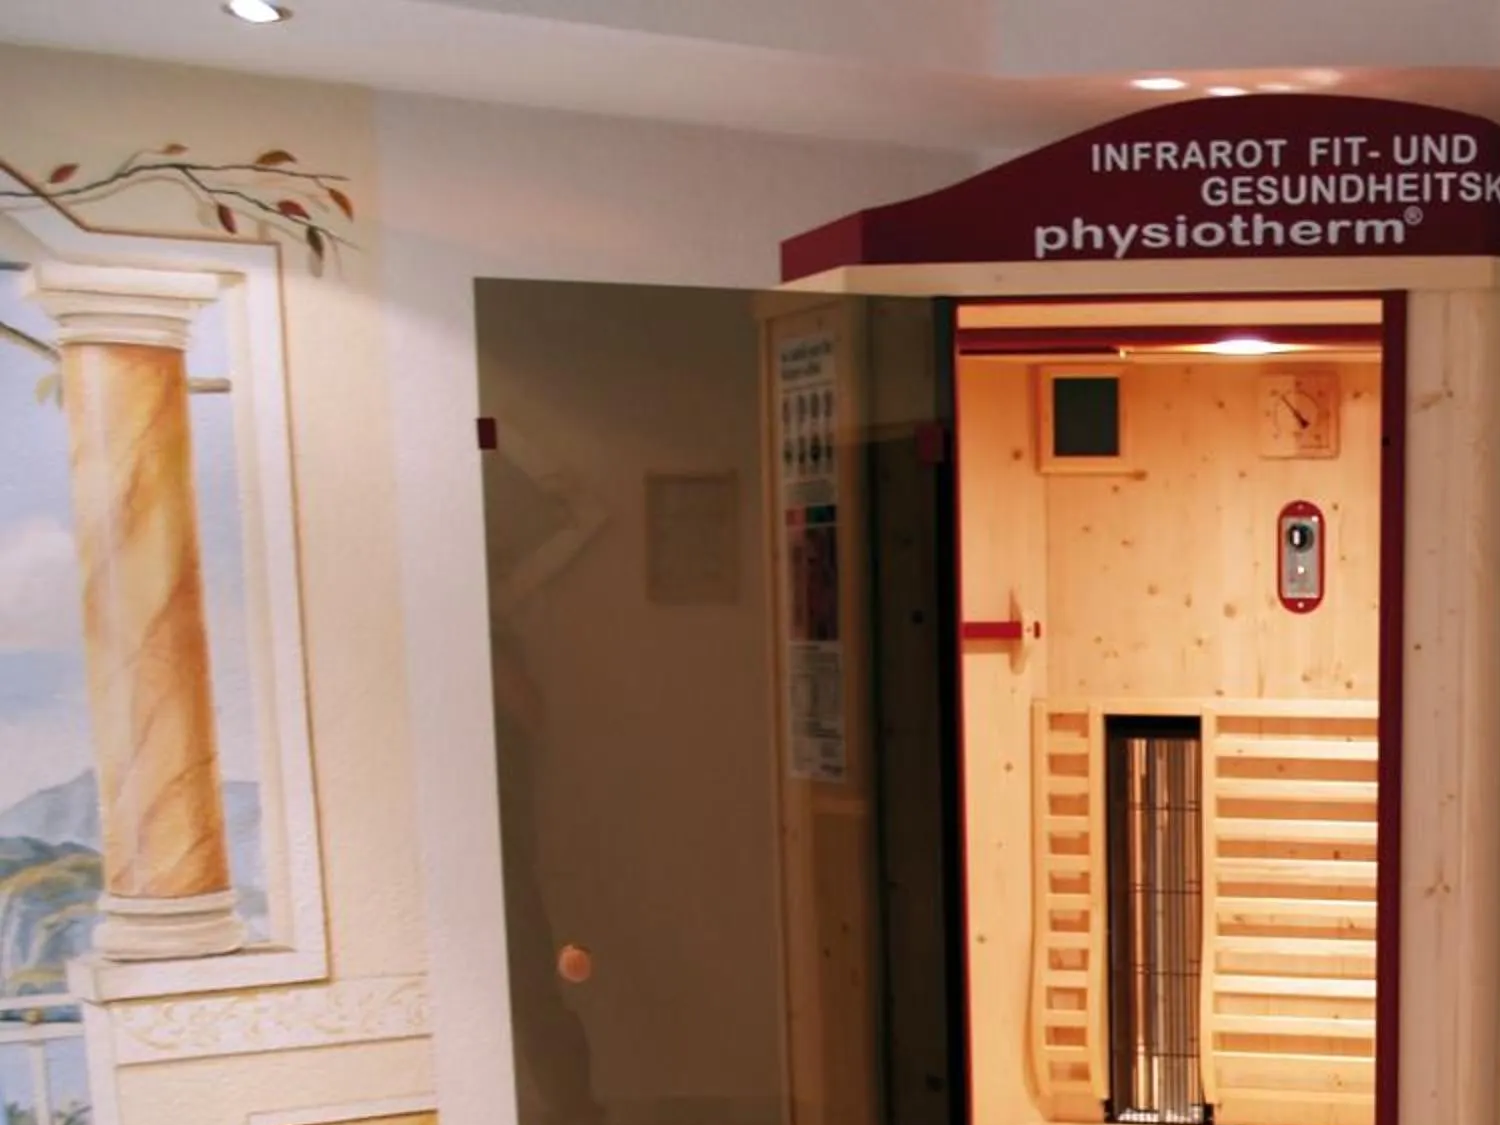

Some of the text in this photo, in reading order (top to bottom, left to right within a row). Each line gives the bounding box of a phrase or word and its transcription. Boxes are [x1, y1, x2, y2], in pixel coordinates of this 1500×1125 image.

[1090, 133, 1479, 172] INFRAROT FIT- UND
